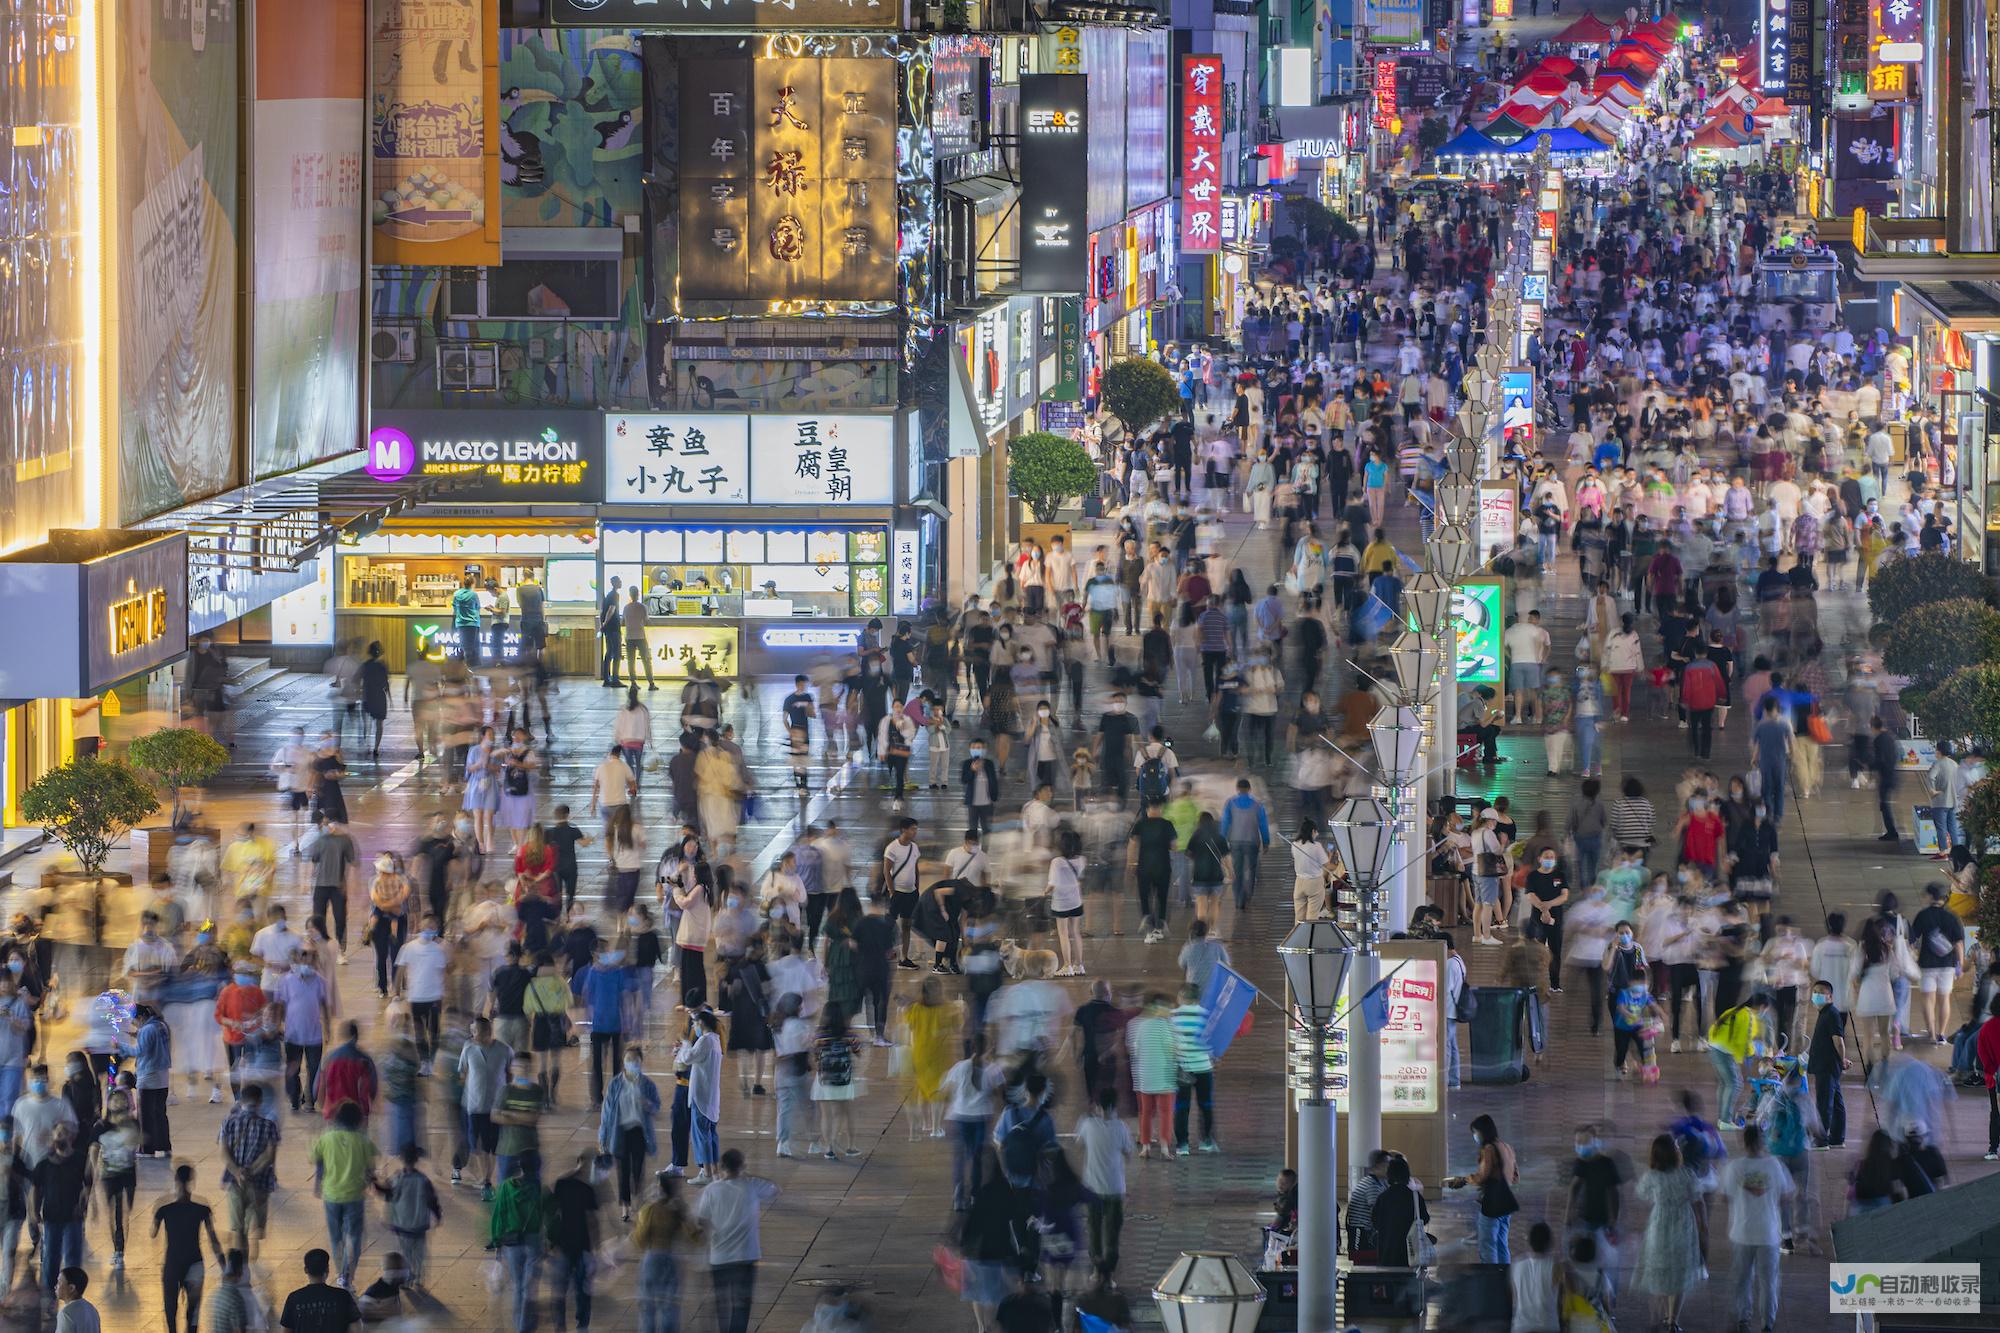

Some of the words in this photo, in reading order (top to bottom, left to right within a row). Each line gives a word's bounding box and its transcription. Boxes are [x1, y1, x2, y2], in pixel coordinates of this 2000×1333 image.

[1028, 111, 1080, 126] EF&C
[1189, 63, 1217, 243] 穿戴大世界
[1297, 139, 1342, 158] HUA
[709, 92, 736, 253] 百年字号
[375, 440, 400, 470] M
[423, 441, 499, 461] MAGIC
[503, 441, 577, 461] LEMON
[645, 424, 710, 457] 章鱼
[794, 420, 822, 479] 豆腐
[423, 463, 450, 474] JUICE
[502, 464, 581, 483] 魔力柠檬
[627, 464, 729, 494] 小丸子
[825, 446, 851, 501] 皇朝
[901, 541, 912, 601] 豆腐皇朝
[479, 632, 519, 644] LEON
[1398, 1066, 1427, 1075] 2020
